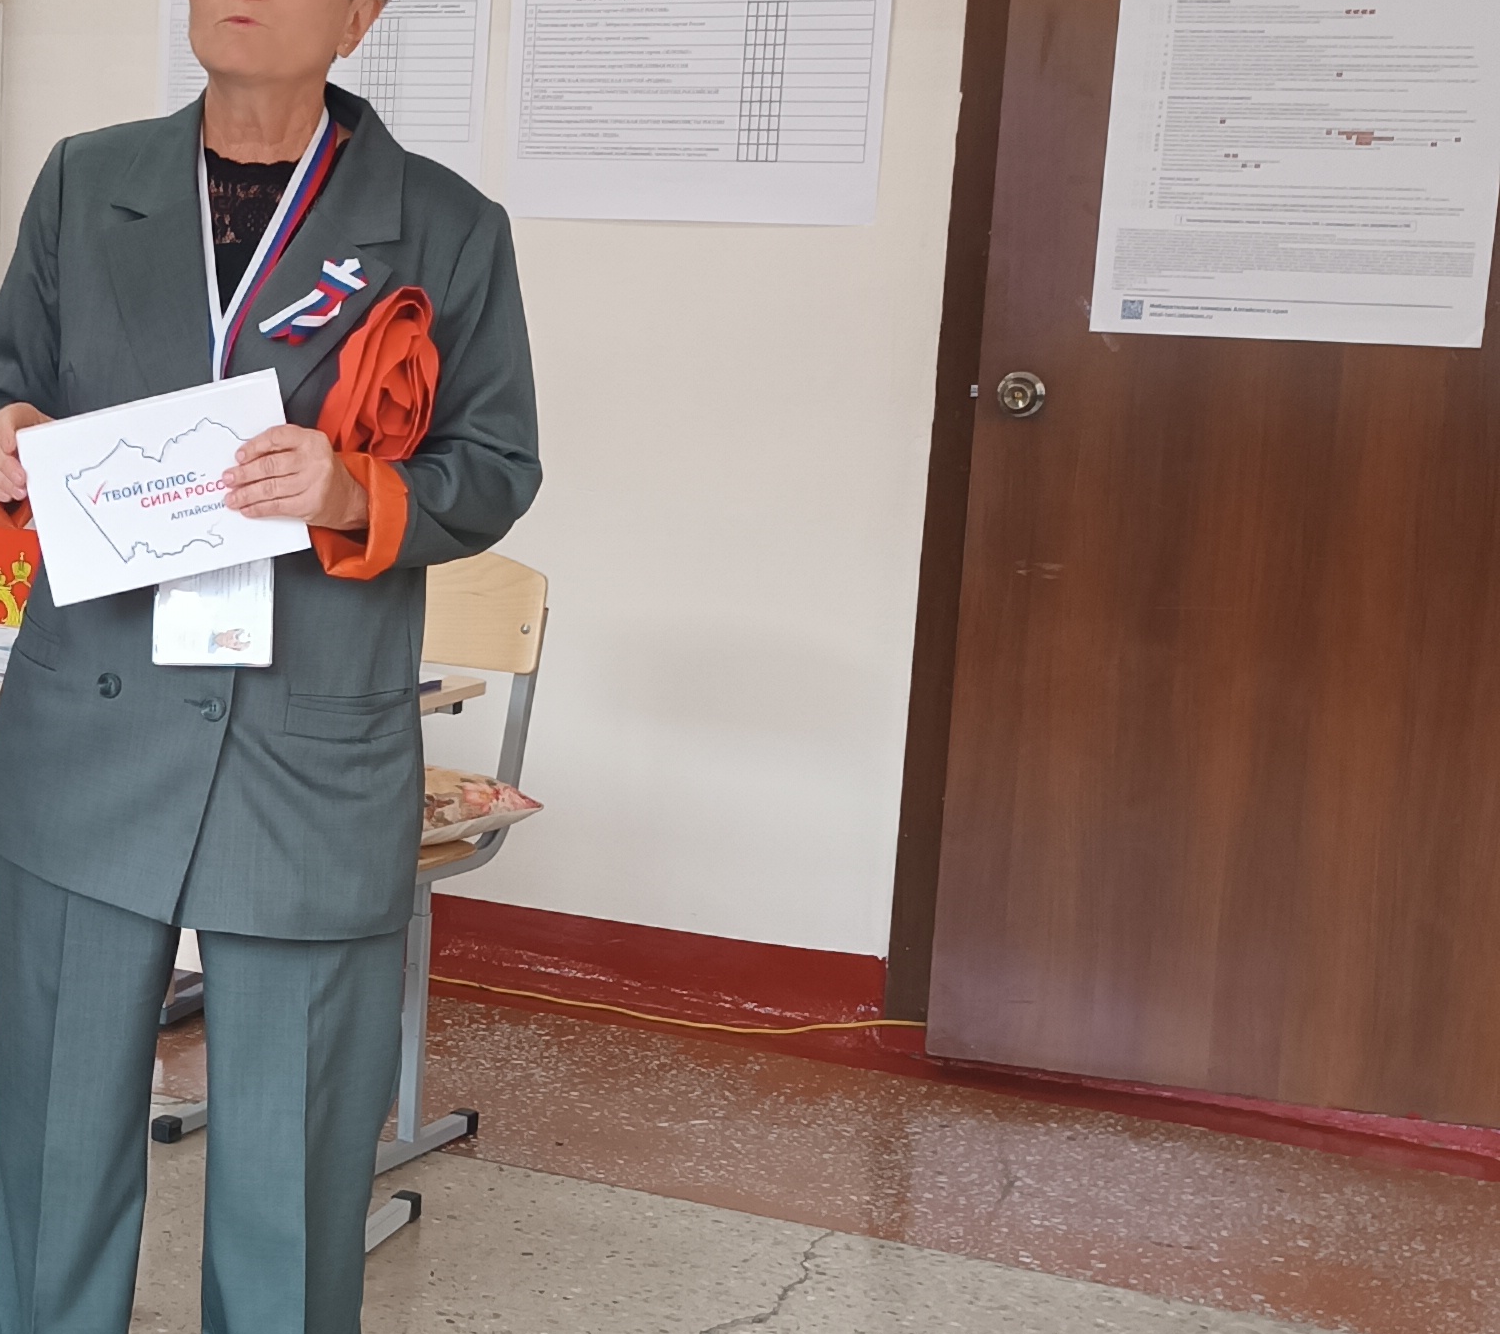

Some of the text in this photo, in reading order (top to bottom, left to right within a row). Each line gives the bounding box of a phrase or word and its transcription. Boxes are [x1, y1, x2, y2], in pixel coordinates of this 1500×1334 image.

[102, 481, 143, 503] ТВОЙ
[147, 471, 198, 493] ГОЛОС
[140, 479, 226, 509] СИЛА РОСС
